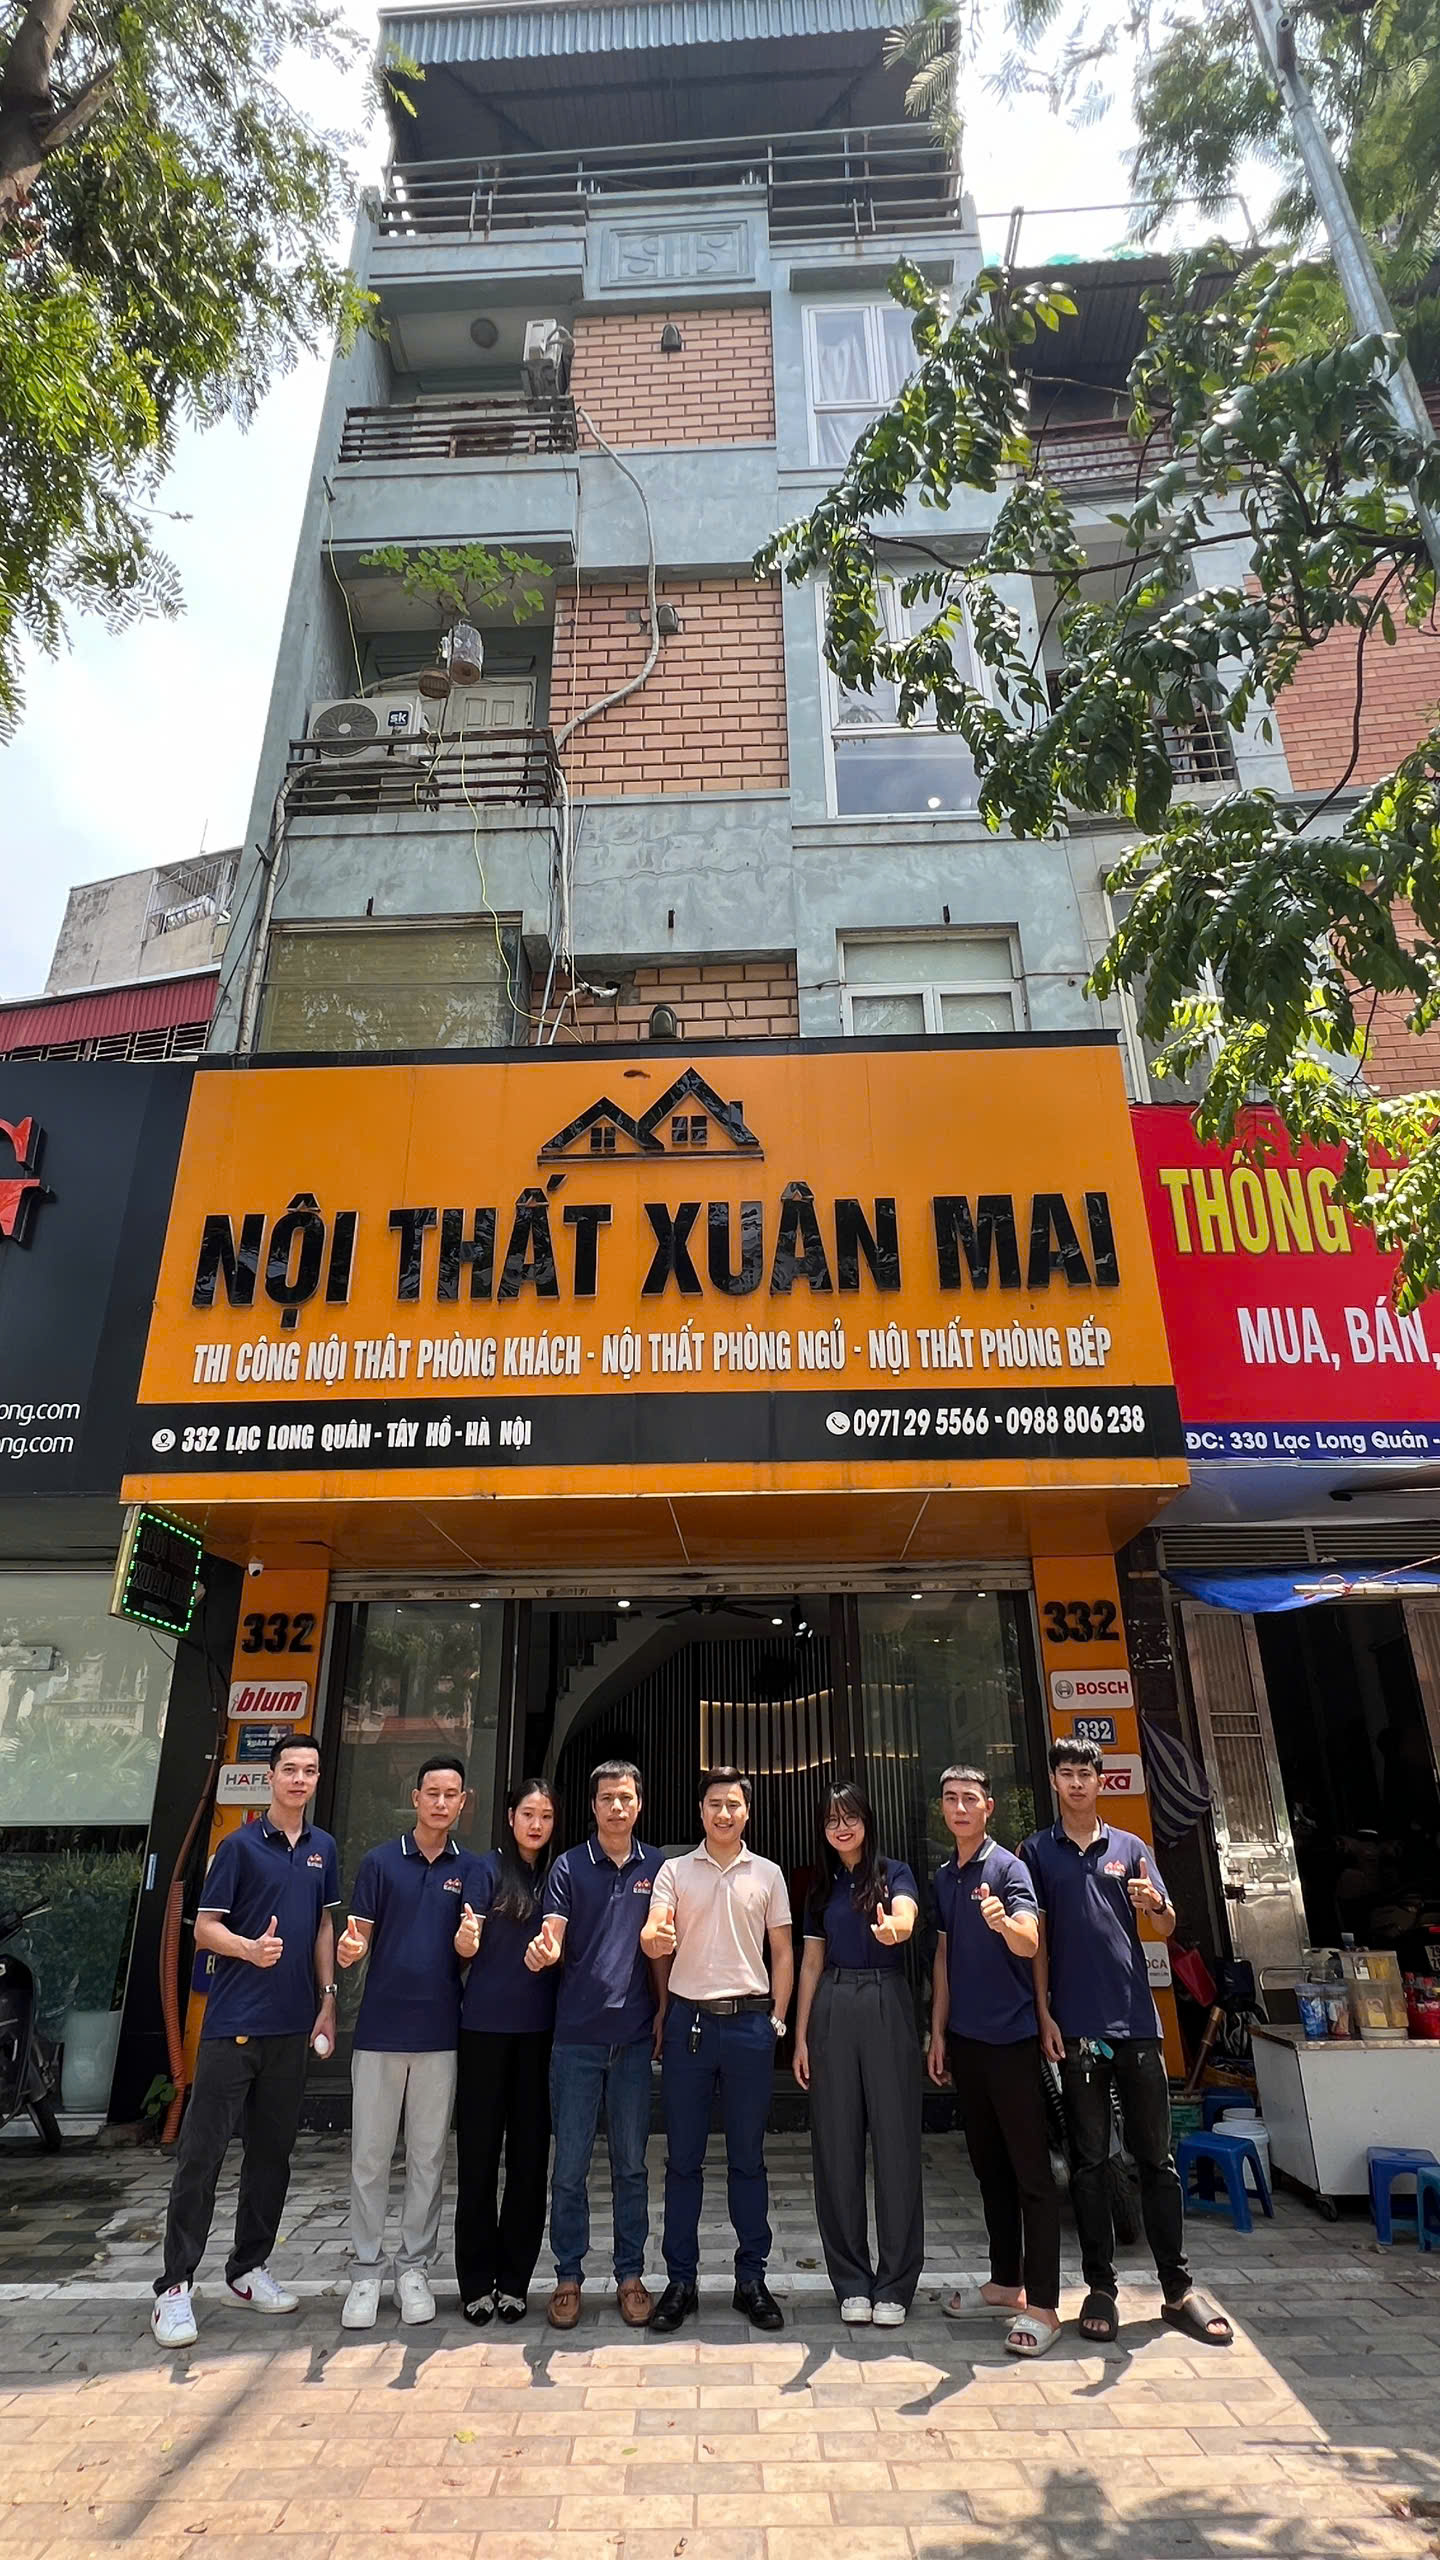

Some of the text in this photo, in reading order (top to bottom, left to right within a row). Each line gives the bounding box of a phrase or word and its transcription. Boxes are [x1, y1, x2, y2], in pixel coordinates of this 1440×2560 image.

[390, 711, 407, 723] sk
[1158, 1149, 1352, 1254] THÔNG
[192, 1173, 1121, 1332] NỘI THẤT XUÂN MAI
[192, 1343, 232, 1384] THI
[235, 1334, 301, 1383] CÔNG
[304, 1332, 348, 1386] NỘI
[416, 1330, 498, 1379] PHÒNG
[503, 1328, 582, 1377] KHÁCH
[601, 1325, 642, 1381] NỘI
[648, 1317, 705, 1373] THẤT
[712, 1322, 792, 1371] PHÒNG
[797, 1316, 846, 1371] NGỦ
[868, 1321, 911, 1376] NỘI
[916, 1315, 975, 1369] THẤT
[980, 1319, 1063, 1369] PHÒNG
[1065, 1314, 1113, 1368] BẾP
[1236, 1295, 1440, 1372] MUA, BÁN,
[181, 1426, 221, 1453] 332
[225, 1424, 262, 1455] LẠC
[266, 1422, 315, 1451] LONG
[320, 1418, 372, 1452] QUÂN
[386, 1417, 420, 1448] TÂY
[425, 1414, 452, 1448] HỒ
[465, 1416, 492, 1447] HÀ
[499, 1415, 532, 1451] NỘI
[853, 1408, 900, 1437] 0971
[903, 1408, 931, 1437] 29
[935, 1407, 990, 1436] 5566
[1005, 1405, 1059, 1435] 0988
[1063, 1405, 1104, 1435] 806
[1107, 1404, 1146, 1434] 238
[0, 1436, 74, 1460] ng.com
[1185, 1431, 1225, 1450] ĐC:
[1230, 1431, 1268, 1450] 330
[1272, 1431, 1311, 1455] Lạc
[1315, 1431, 1367, 1454] Long
[1371, 1429, 1429, 1450] Quân
[241, 1612, 316, 1654] 332
[1044, 1600, 1120, 1643] 332
[236, 1687, 303, 1713] blum
[1075, 1681, 1129, 1696] BOSCH
[1077, 1720, 1112, 1740] 332
